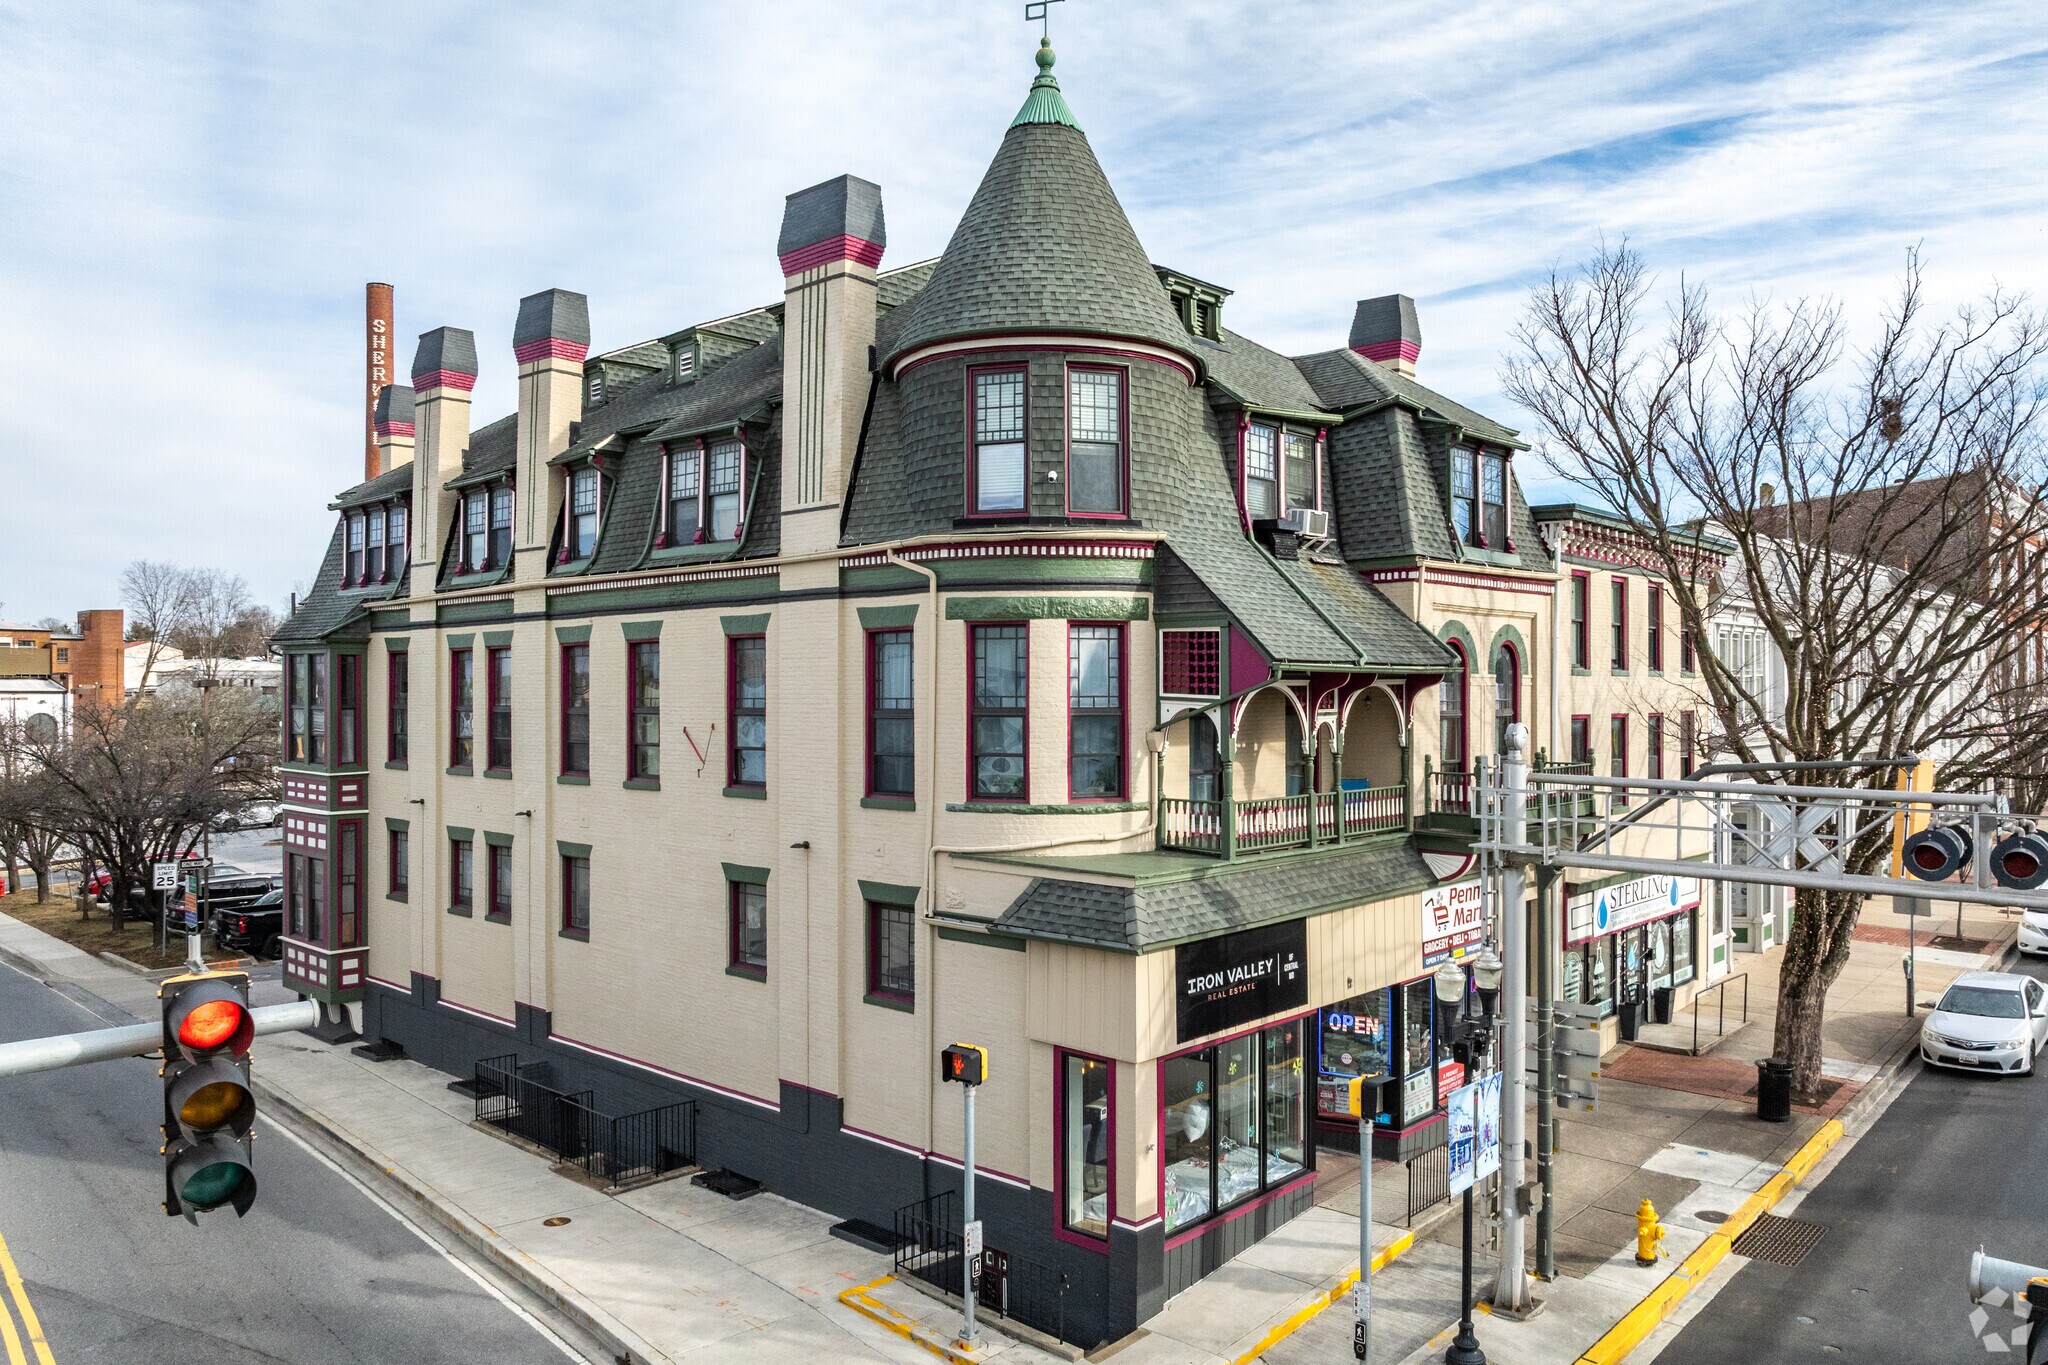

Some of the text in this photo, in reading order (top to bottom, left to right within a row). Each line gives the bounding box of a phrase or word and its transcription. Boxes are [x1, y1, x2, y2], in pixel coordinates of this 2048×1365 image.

[156, 876, 175, 887] 25
[1610, 875, 1668, 909] STERLING
[1449, 885, 1481, 906] Penn
[1424, 937, 1449, 954] GROCERY
[1452, 932, 1464, 946] DELI
[1467, 925, 1491, 941] TOBAO
[1425, 957, 1437, 965] OPEN
[1187, 958, 1274, 994] IRON VALLEY
[1207, 983, 1256, 1001] REAL ESTATE
[1328, 1013, 1379, 1035] OPEN
